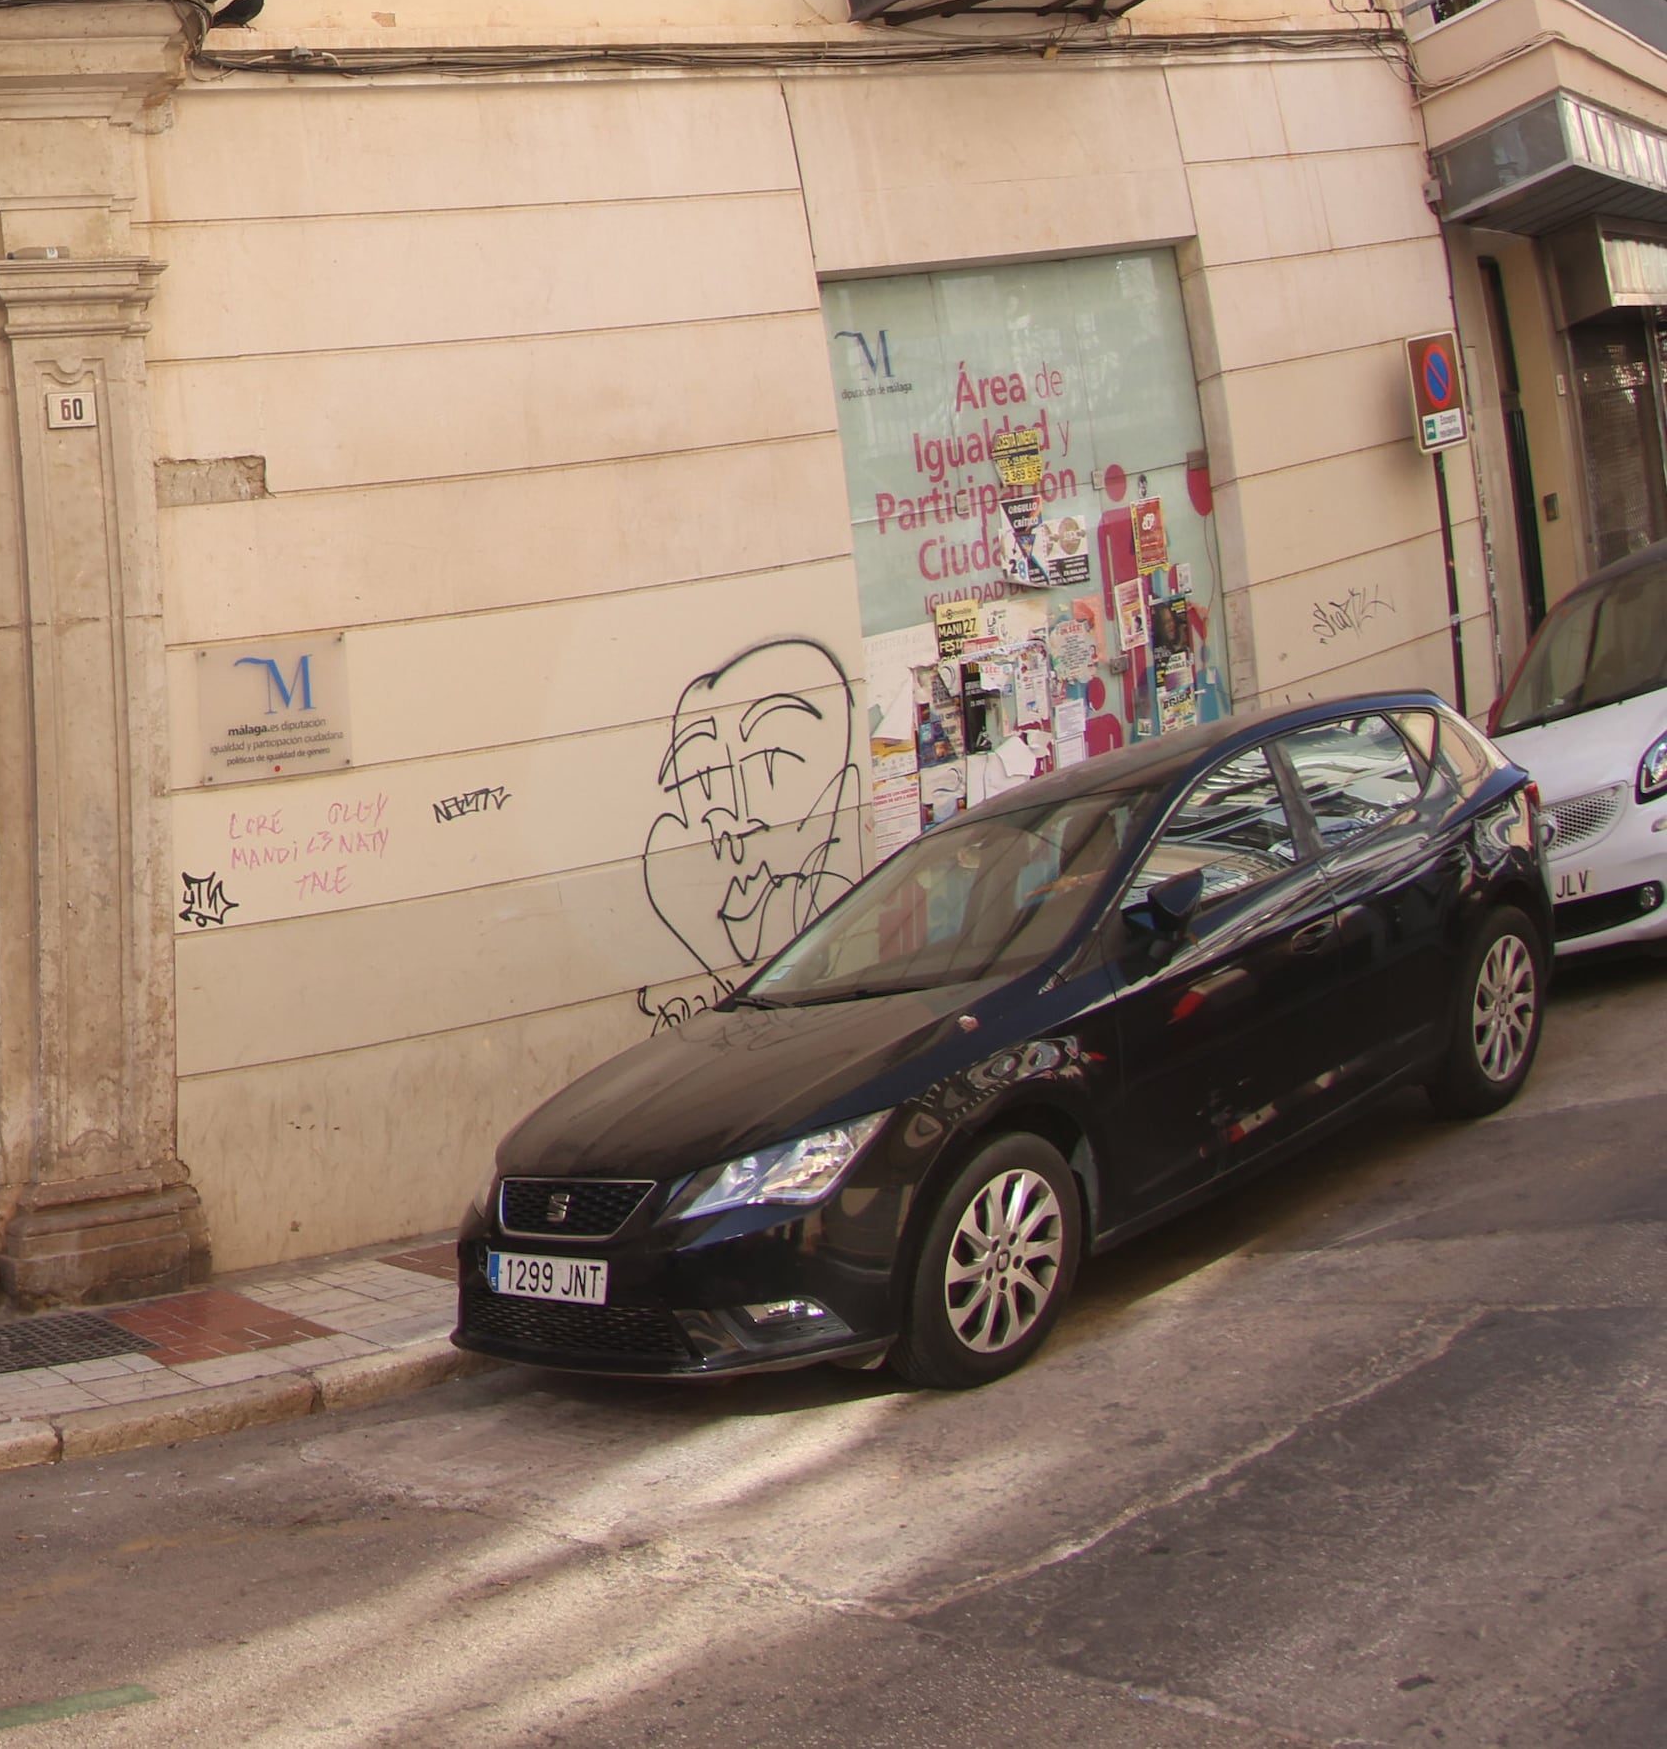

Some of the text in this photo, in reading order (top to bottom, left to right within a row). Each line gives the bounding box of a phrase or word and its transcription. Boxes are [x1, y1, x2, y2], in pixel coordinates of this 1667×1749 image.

[955, 360, 1063, 412] Área de
[60, 398, 83, 421] 60
[913, 408, 1070, 483] Iguald y
[1007, 501, 1038, 515] ORGULLO
[964, 617, 977, 633] 27
[233, 654, 317, 714] M
[227, 718, 326, 738] málaga.es diputación
[210, 741, 245, 756] igualdad
[253, 735, 303, 751] participación
[303, 730, 344, 743] ciudadana
[256, 753, 265, 762] de
[267, 750, 296, 763] igualdad
[296, 749, 306, 758] de
[1555, 869, 1589, 898] JLV
[505, 1258, 602, 1298] 1299 JNT
